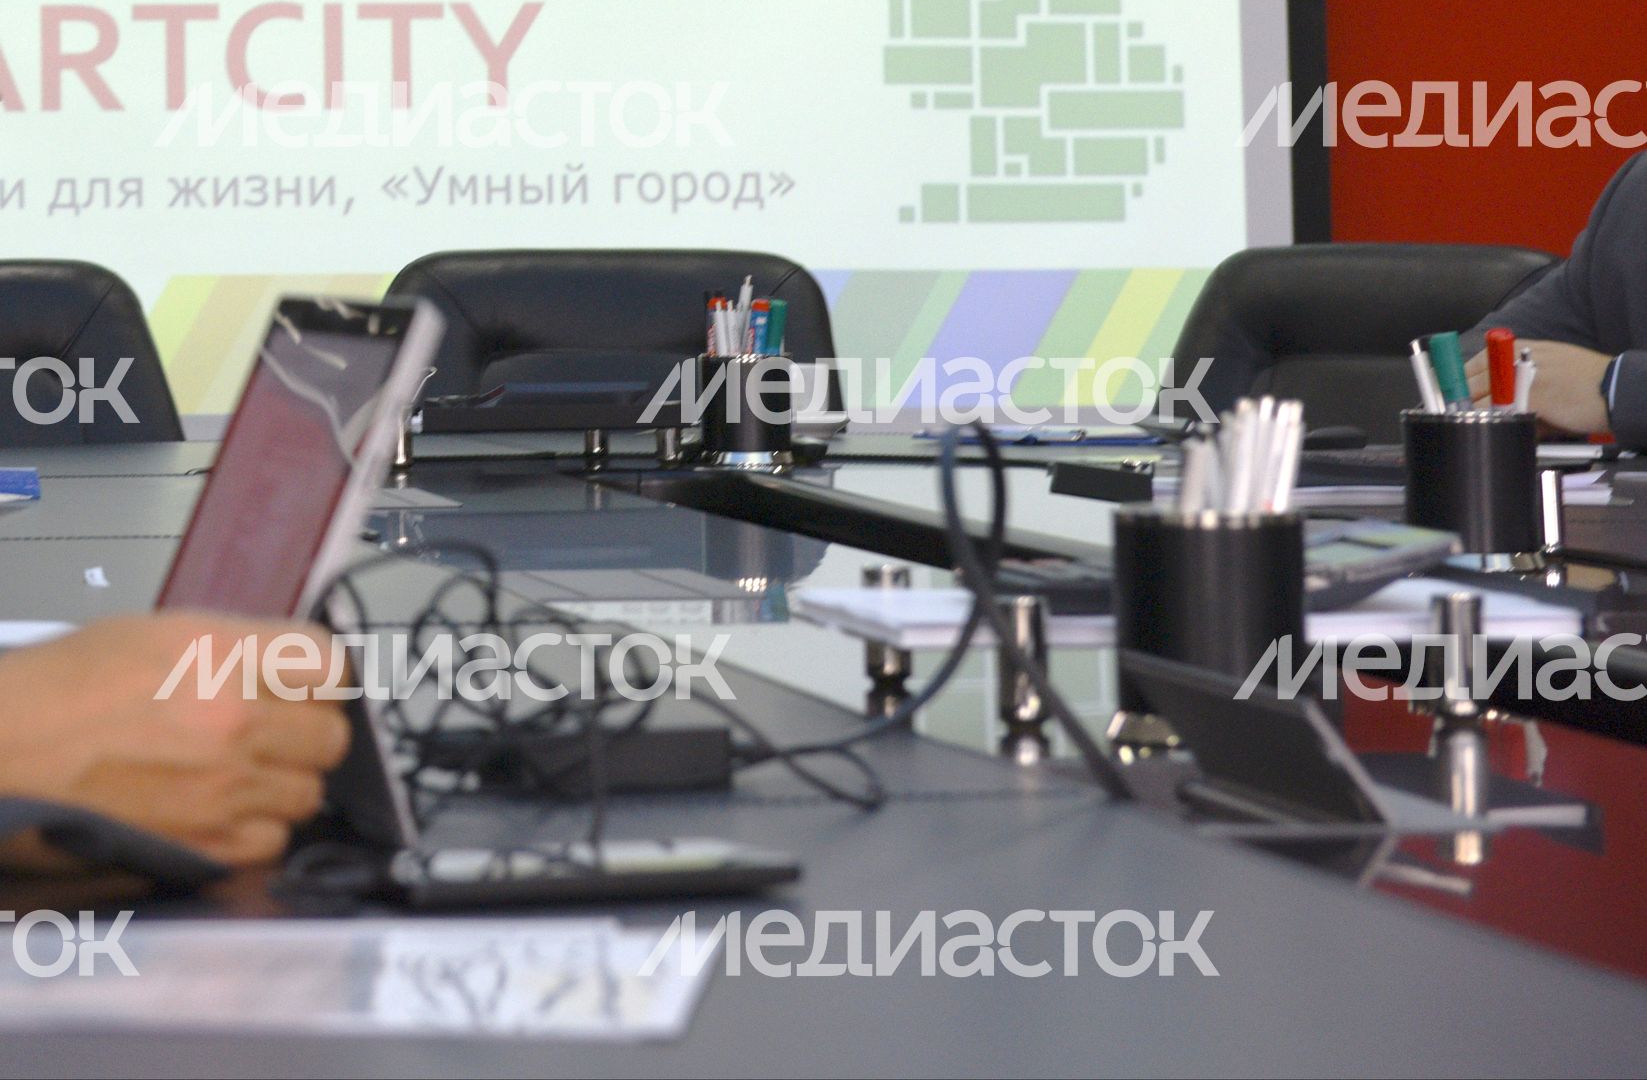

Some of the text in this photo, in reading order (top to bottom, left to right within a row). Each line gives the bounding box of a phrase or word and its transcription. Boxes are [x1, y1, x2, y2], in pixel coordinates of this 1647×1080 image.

[47, 176, 145, 216] для
[167, 175, 356, 215] жизни,
[380, 162, 589, 207] «Умный
[613, 170, 796, 215] город»
